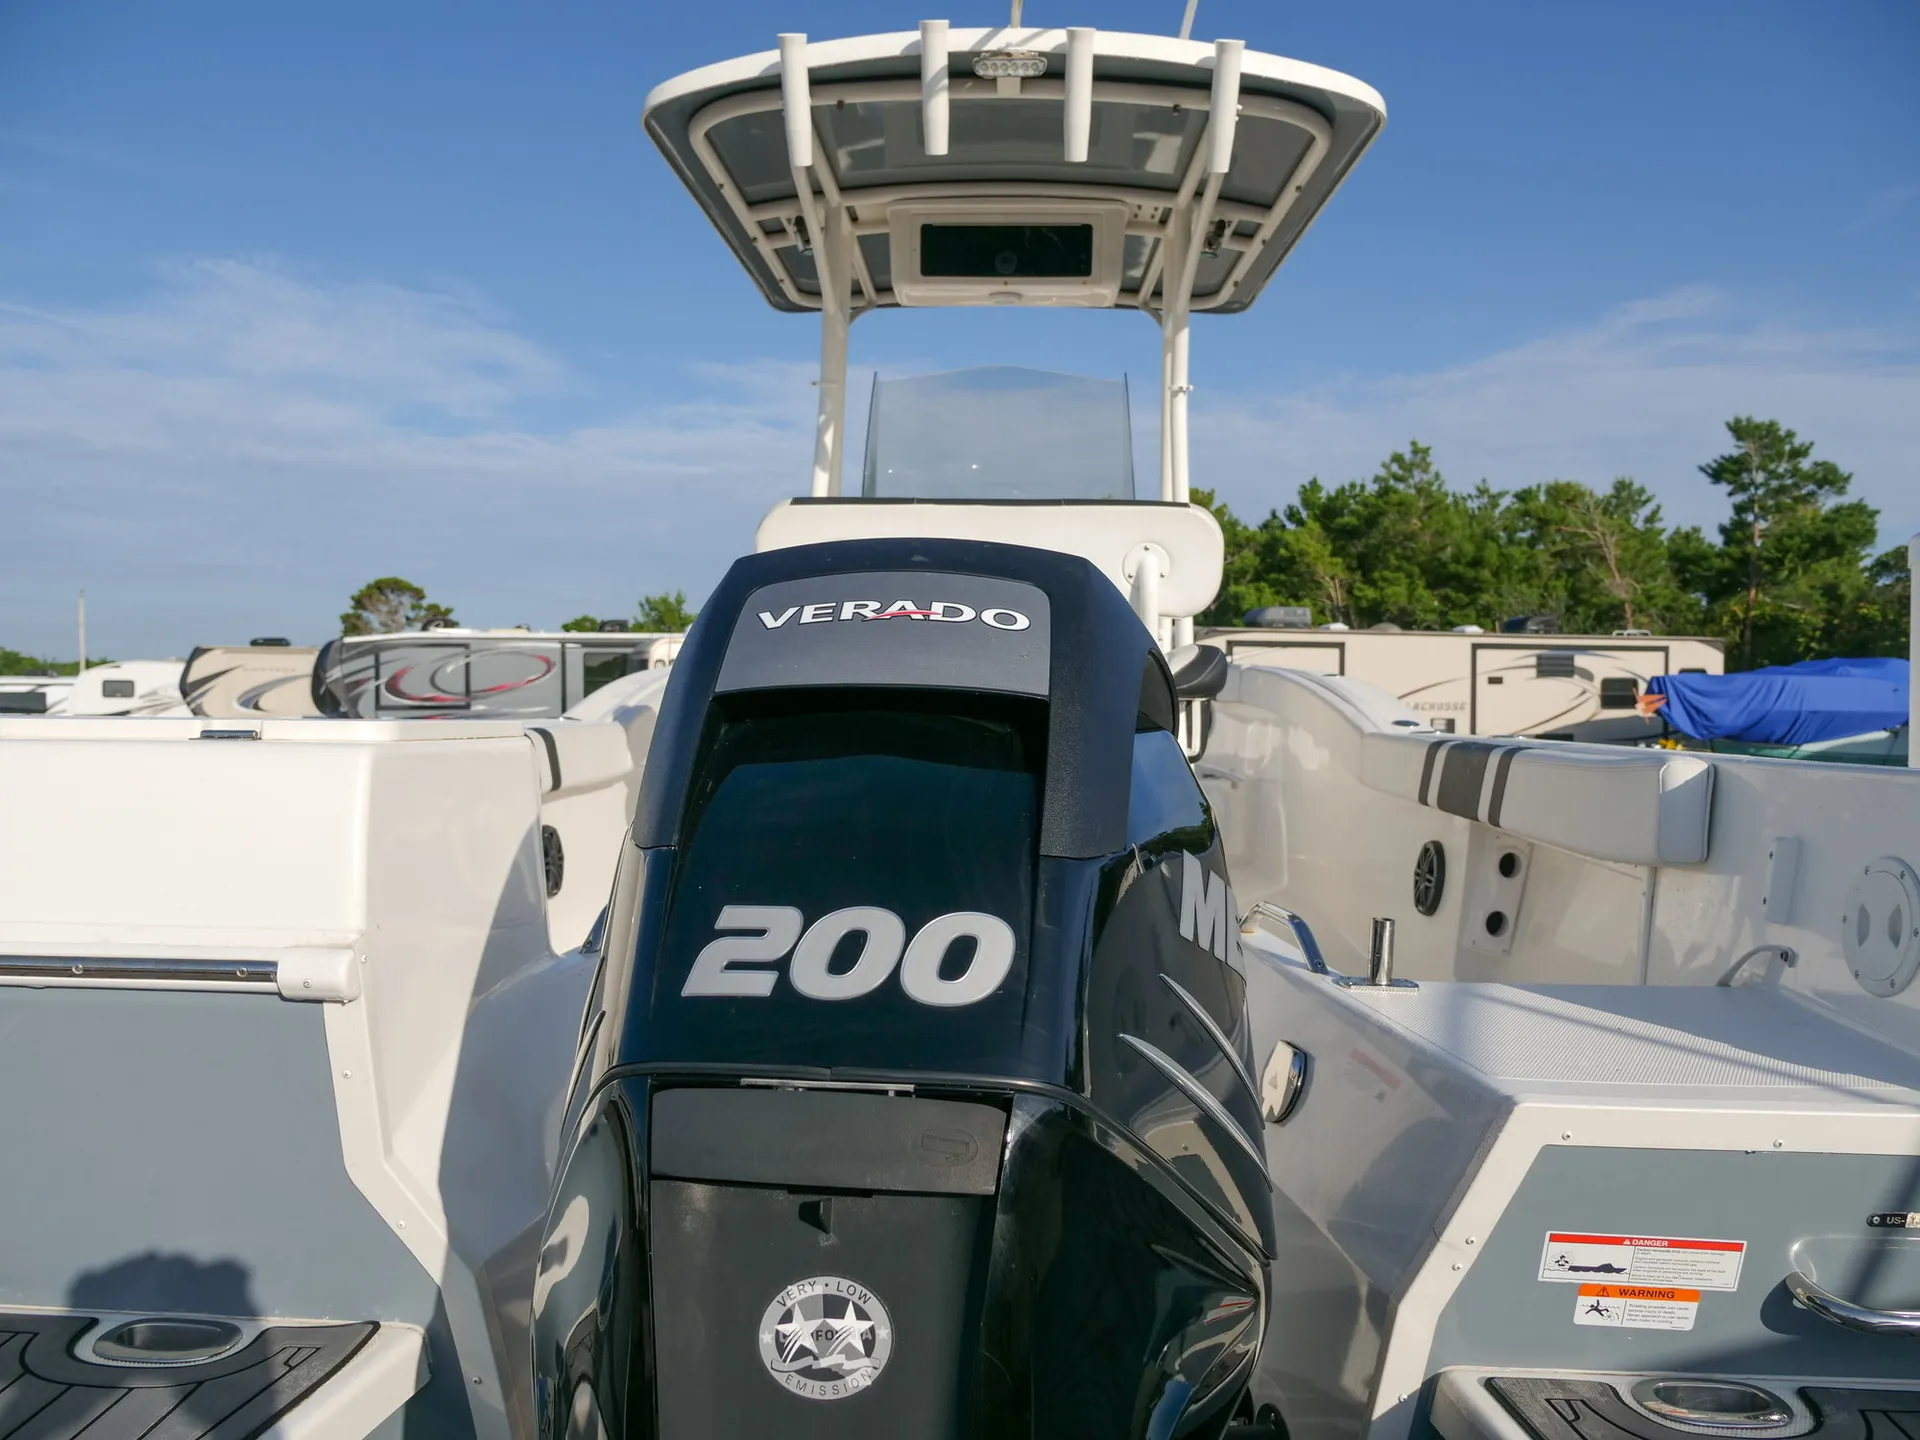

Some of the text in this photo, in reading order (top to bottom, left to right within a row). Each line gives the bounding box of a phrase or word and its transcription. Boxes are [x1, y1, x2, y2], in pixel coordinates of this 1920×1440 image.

[756, 599, 1032, 632] VERADO
[681, 905, 1017, 1007] 200
[1632, 1239, 1668, 1247] DANGER
[776, 1280, 872, 1308] VERY LOW
[1619, 1288, 1675, 1299] WARNING
[785, 1369, 872, 1396] EMISSION
